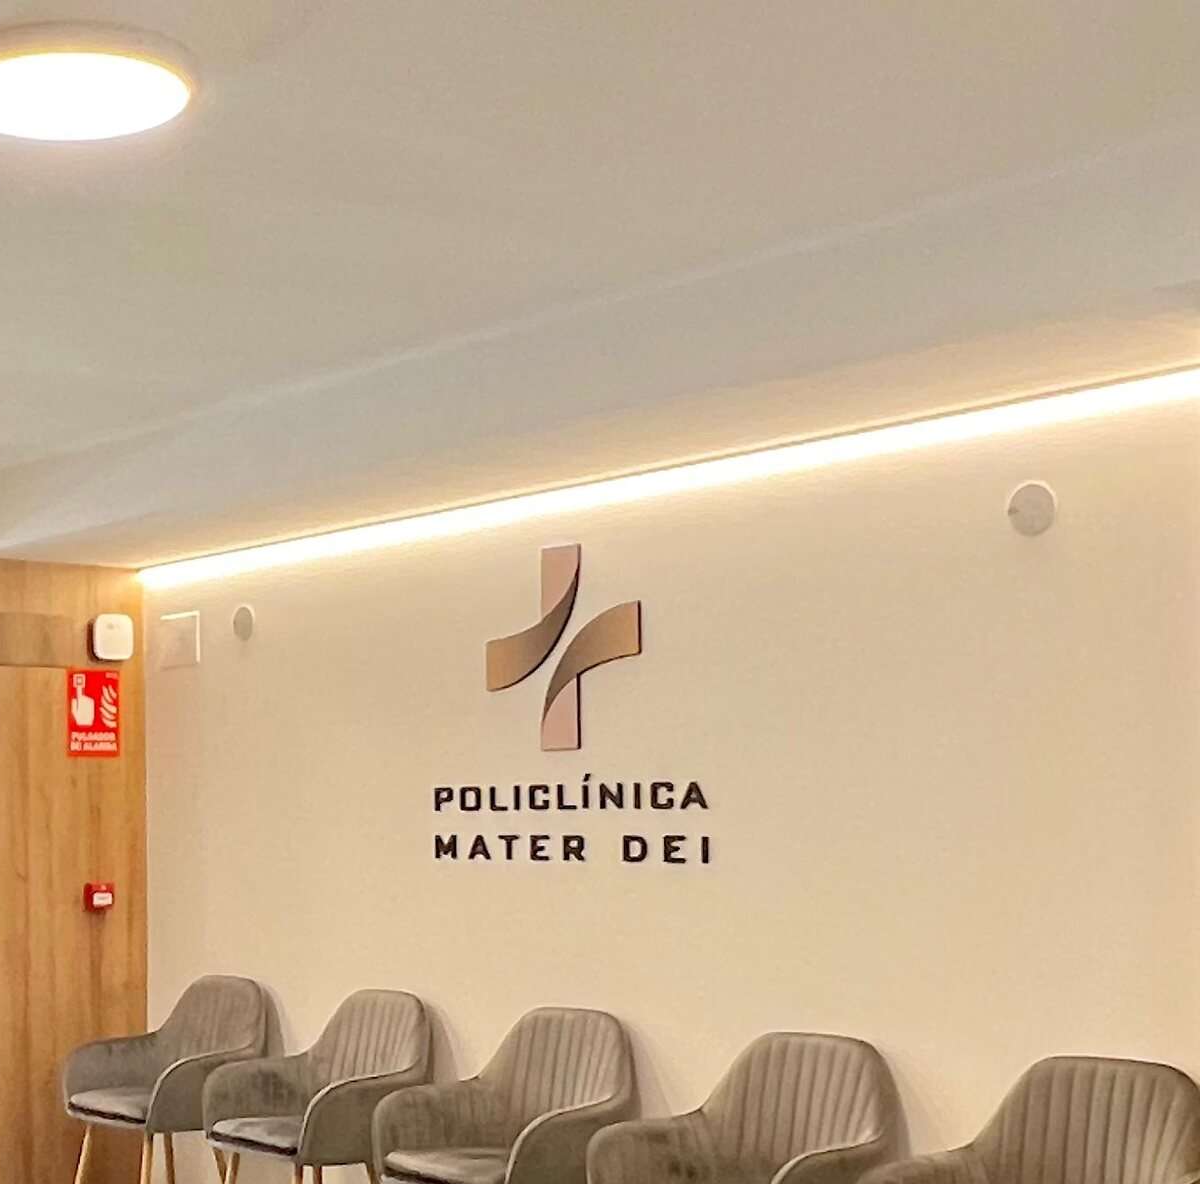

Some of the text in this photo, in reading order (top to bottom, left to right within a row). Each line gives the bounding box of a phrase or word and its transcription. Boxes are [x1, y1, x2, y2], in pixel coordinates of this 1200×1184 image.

[433, 773, 709, 812] POLICLÍNICA
[434, 834, 710, 864] MATER DEI
